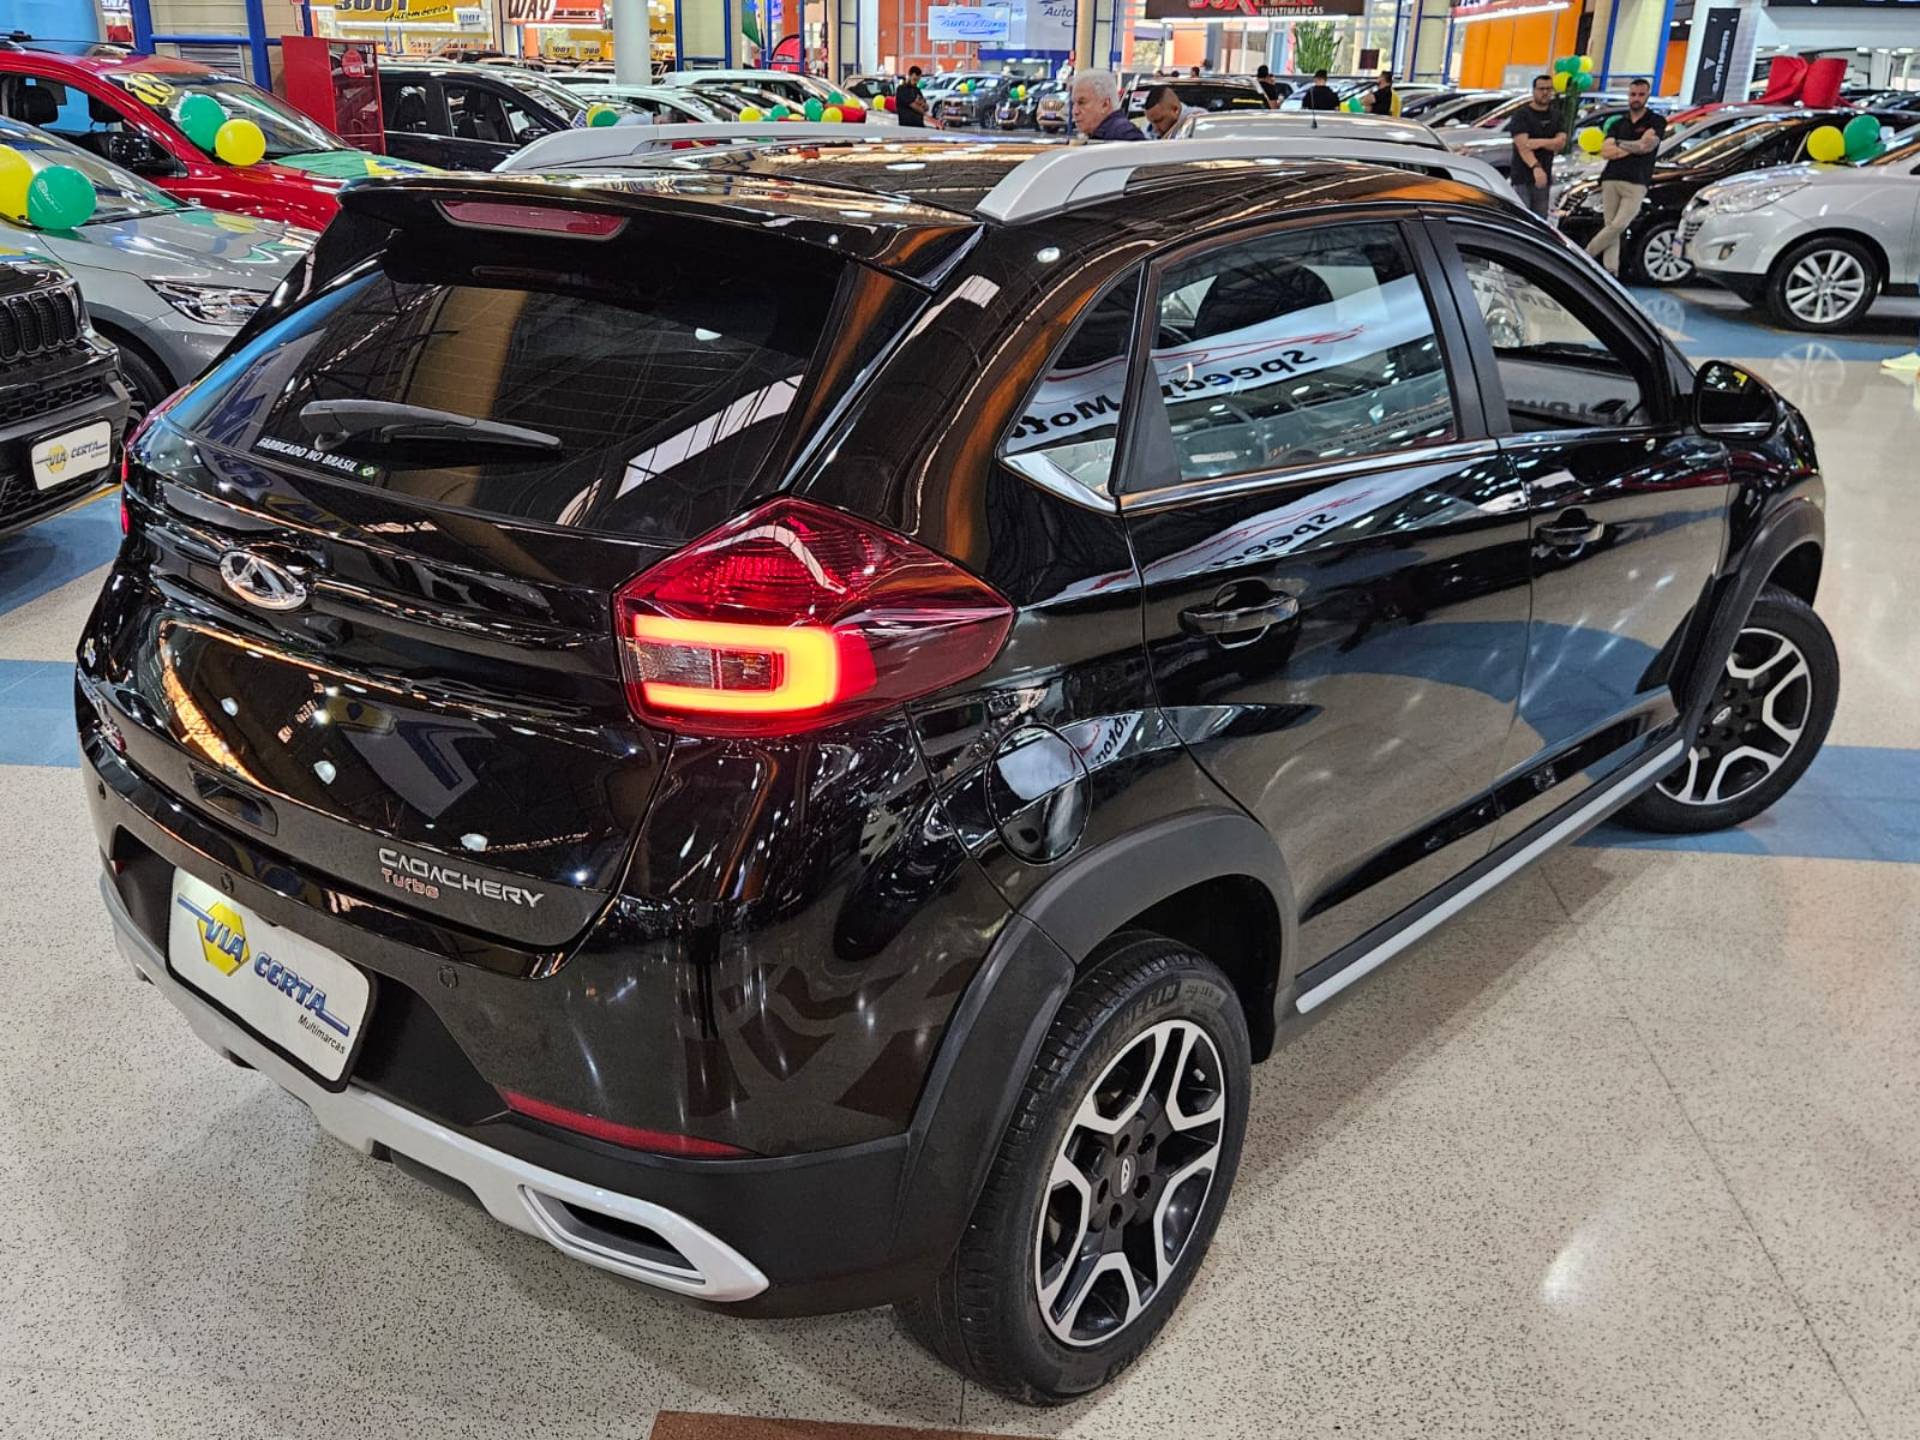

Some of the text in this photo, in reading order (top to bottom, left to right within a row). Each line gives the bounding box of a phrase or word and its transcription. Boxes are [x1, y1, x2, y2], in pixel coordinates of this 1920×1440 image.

[509, 0, 550, 18] WAY
[1044, 6, 1073, 17] Auto
[1261, 7, 1324, 16] MULTIMARCAS
[256, 437, 358, 472] FABRICADO NO BRASIL
[381, 867, 440, 899] Turbo
[204, 916, 328, 1016] VIA CERTA
[298, 1013, 346, 1056] Multimarcas
